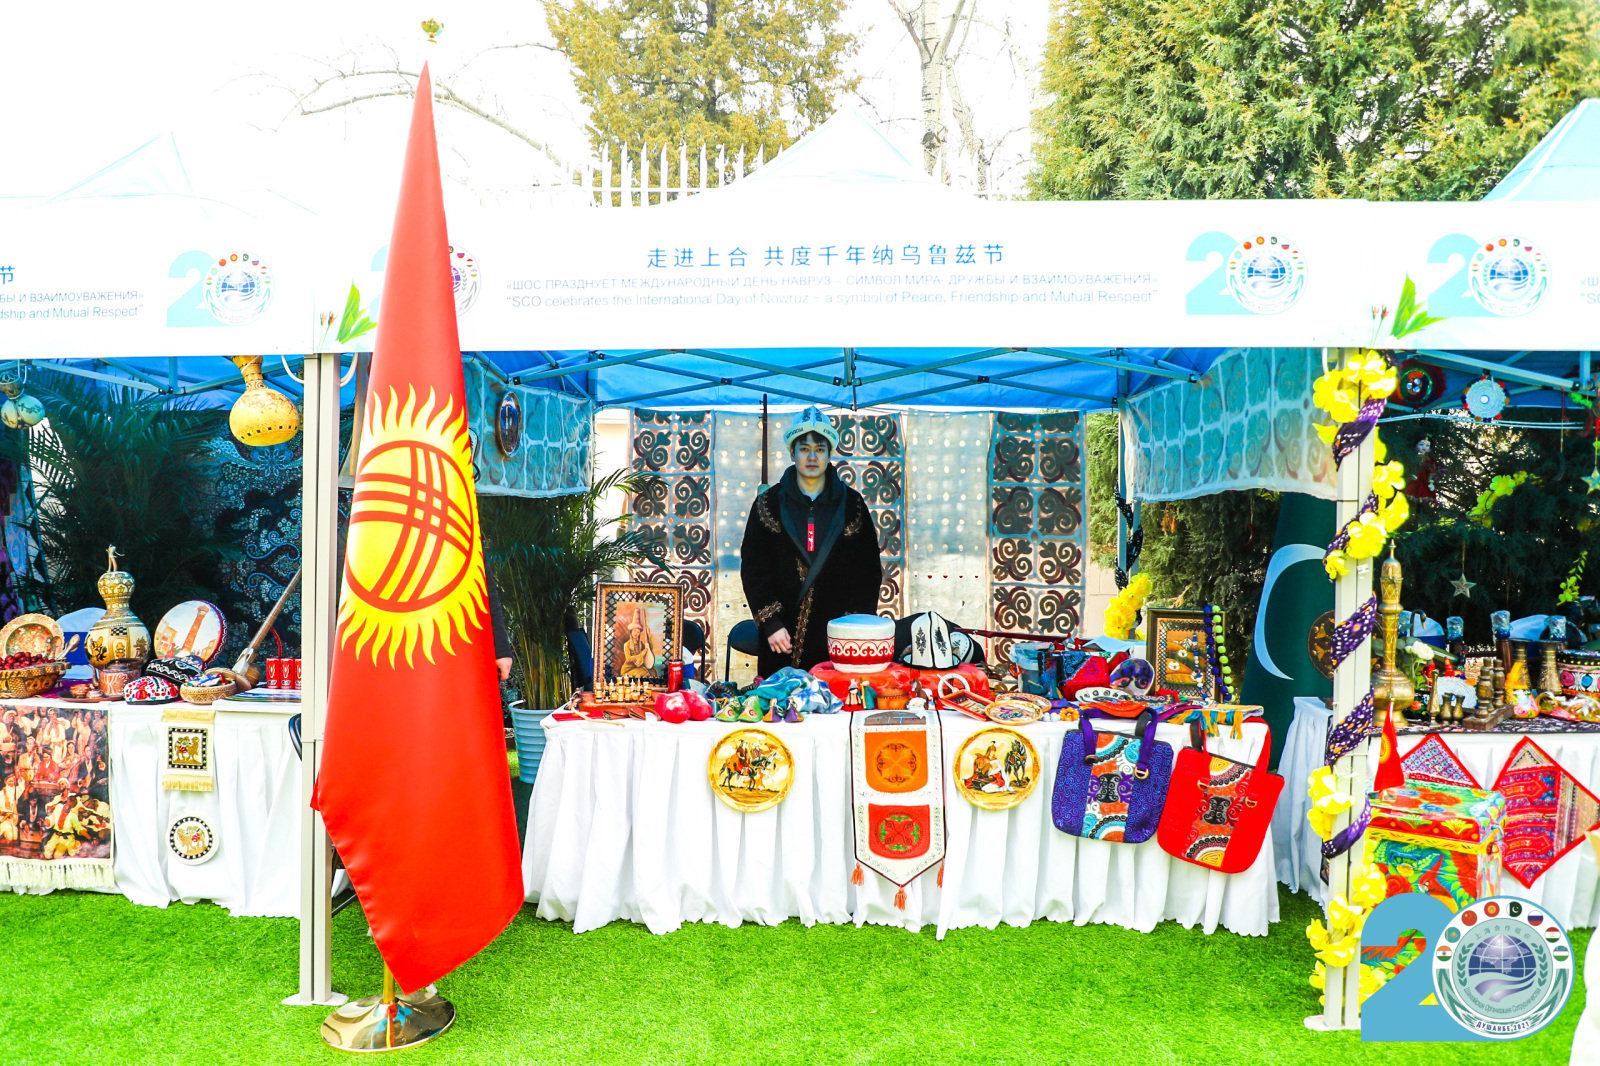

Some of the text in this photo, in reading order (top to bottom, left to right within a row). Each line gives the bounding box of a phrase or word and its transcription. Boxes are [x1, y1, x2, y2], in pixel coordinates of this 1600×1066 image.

[647, 244, 1005, 269] 走进上合 共度千年纳乌鲁兹节
[545, 278, 617, 290] ПРАЗДНУЕТ
[621, 276, 740, 290] МЕЖДУНАРОДНЫЙ
[743, 275, 778, 288] ДЕНЬ
[781, 275, 832, 287] НАВРУЗ
[846, 275, 901, 286] СИМВОЛ
[948, 274, 1006, 286] ДРУЖБЫ
[1009, 274, 1019, 285] И
[544, 295, 609, 308] celebrates
[612, 294, 633, 306] the
[635, 293, 713, 306] International
[715, 292, 742, 307] Day
[744, 293, 757, 305] of
[760, 292, 809, 305] Nowruz
[823, 295, 833, 304] a
[836, 292, 883, 306] symbol
[885, 292, 898, 304] of
[950, 290, 1019, 305] Friendship
[1021, 291, 1047, 304] and
[1050, 290, 1095, 304] Mutual
[28, 308, 50, 319] and
[52, 306, 89, 319] Mutual
